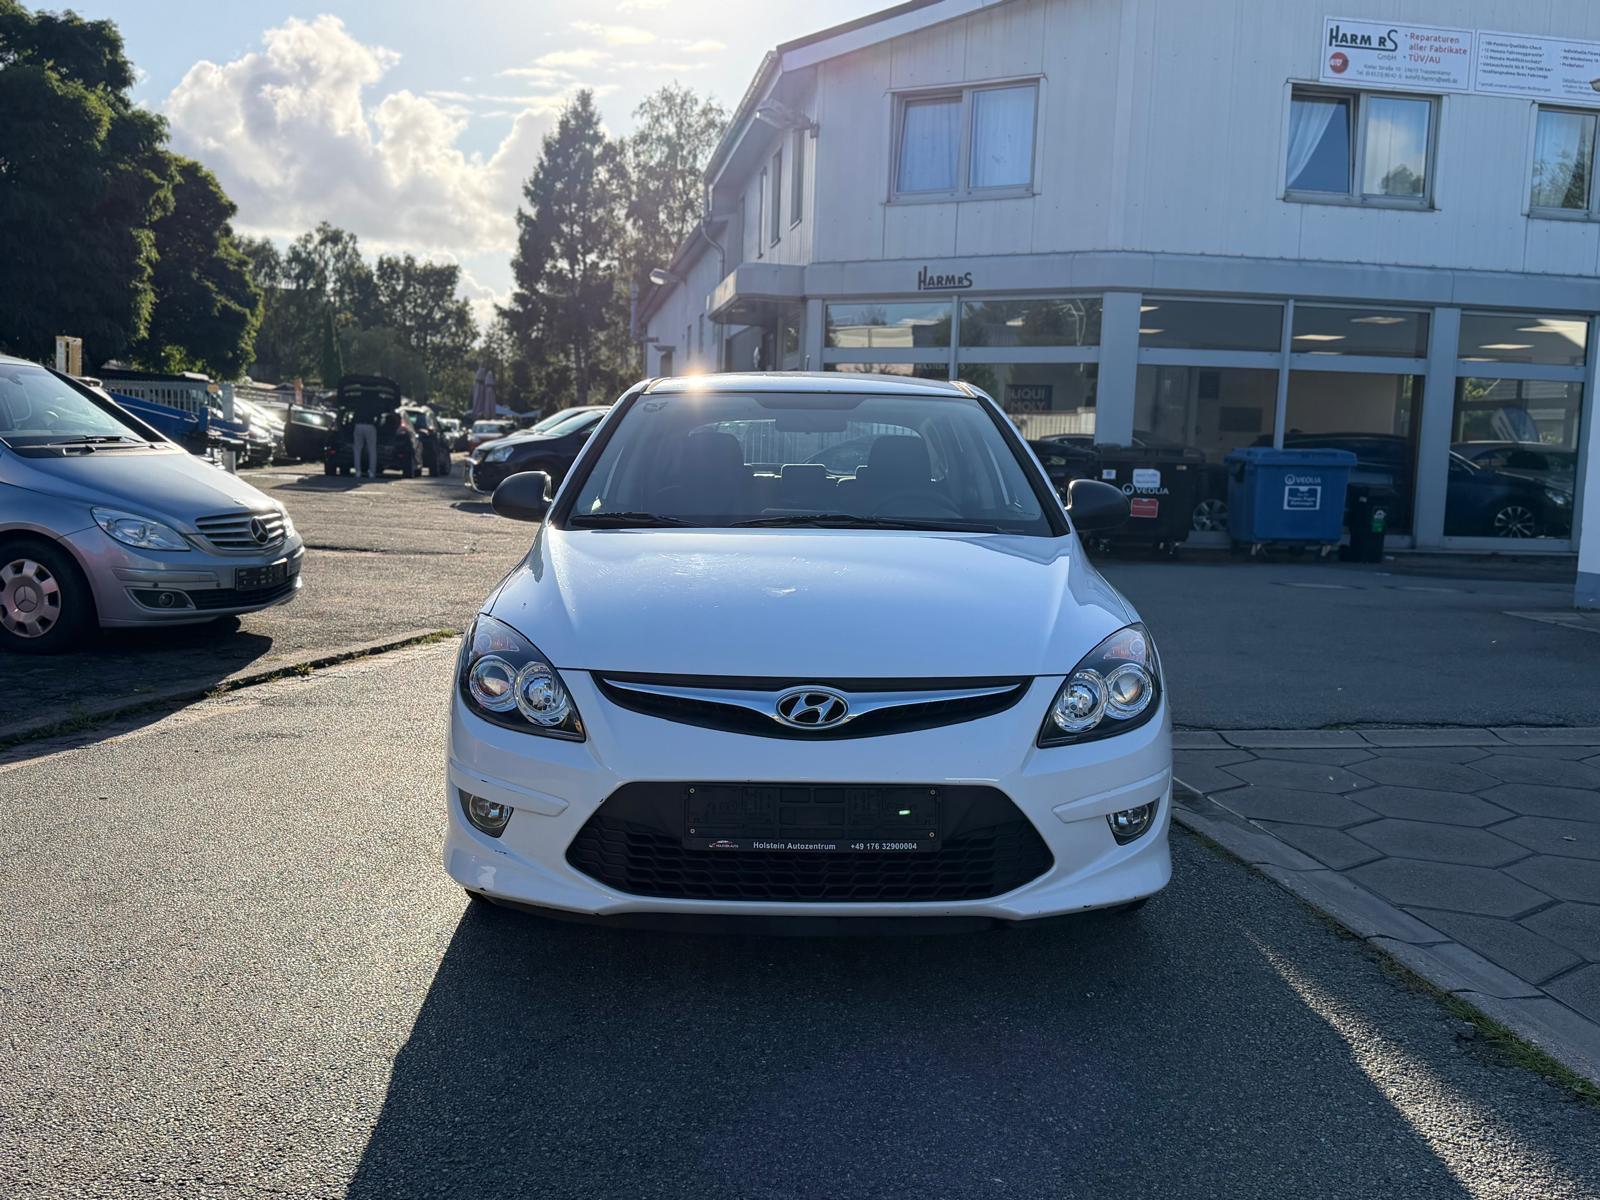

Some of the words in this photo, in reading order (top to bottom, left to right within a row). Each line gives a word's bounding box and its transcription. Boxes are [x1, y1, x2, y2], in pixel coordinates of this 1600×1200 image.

[1409, 32, 1460, 44] Reparaturen
[1408, 43, 1427, 52] aller
[1429, 46, 1468, 55] Fabrikate
[1377, 53, 1397, 61] GmbH
[1408, 53, 1441, 64] TÜV/AU
[1296, 476, 1321, 484] VEOLIA
[1136, 487, 1169, 495] VEOLIA
[753, 841, 785, 850] Holstein
[787, 842, 836, 850] Autozentrum
